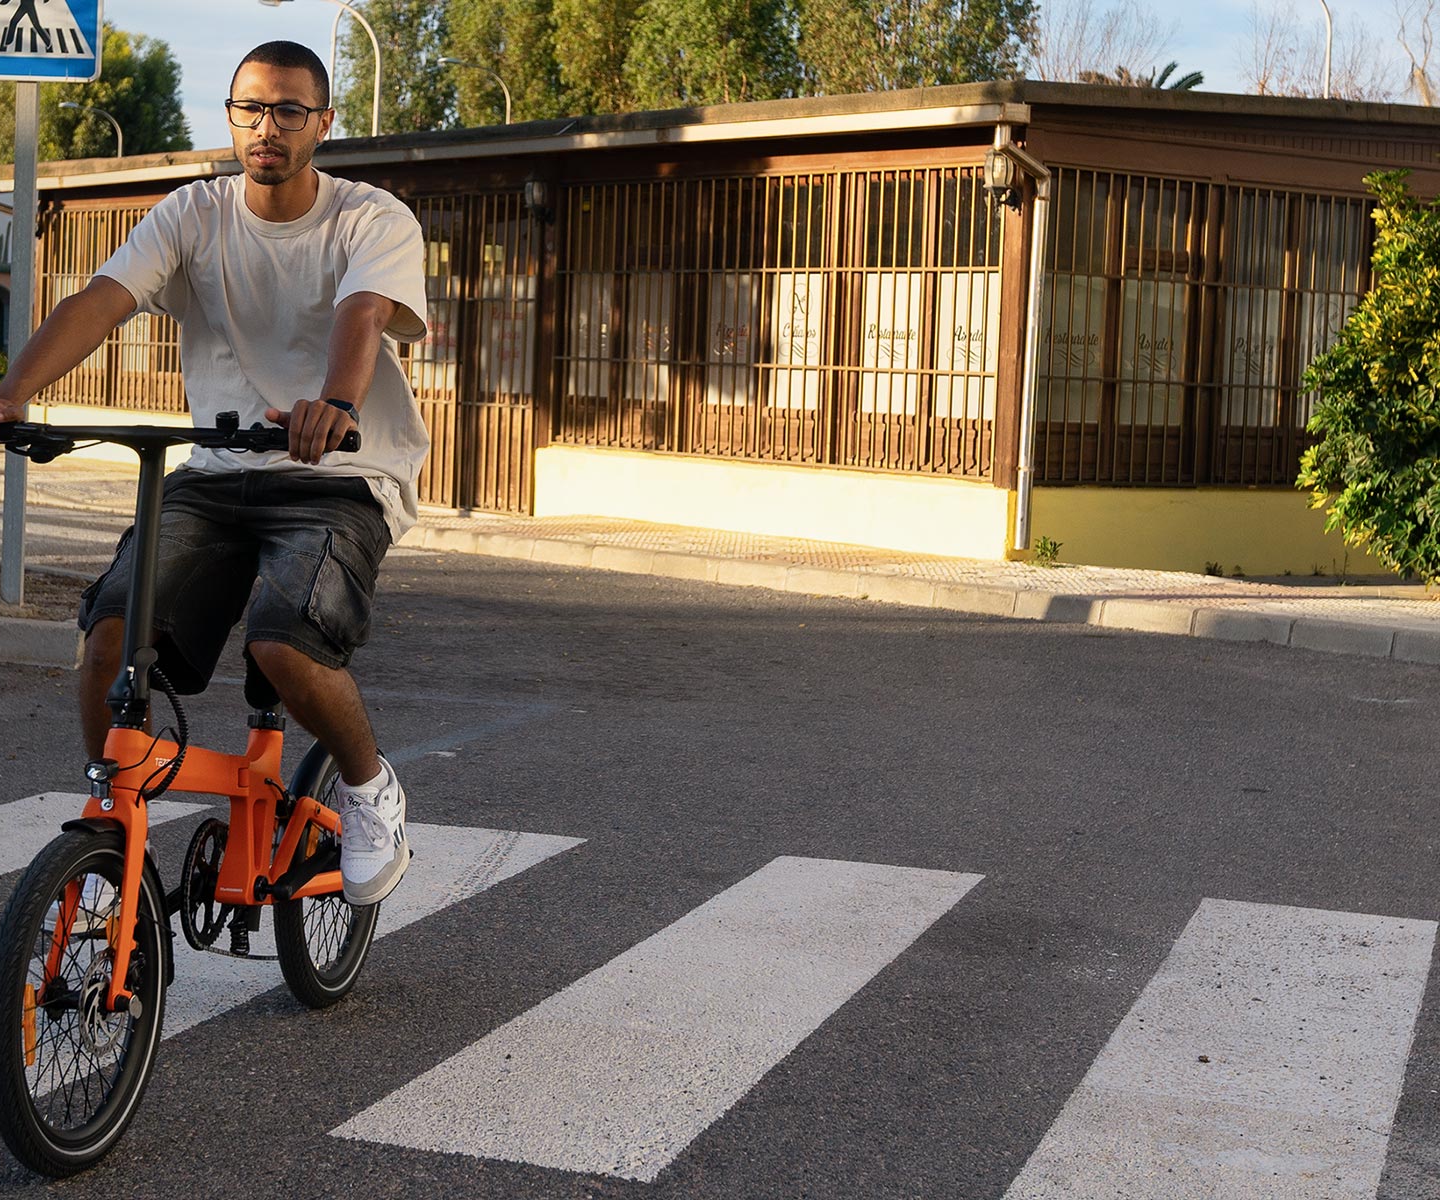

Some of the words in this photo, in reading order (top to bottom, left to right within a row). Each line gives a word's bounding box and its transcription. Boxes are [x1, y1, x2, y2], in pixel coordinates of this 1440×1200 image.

[867, 323, 917, 340] Rstarante
[954, 325, 987, 342] Asdo
[1137, 333, 1175, 351] Asdo
